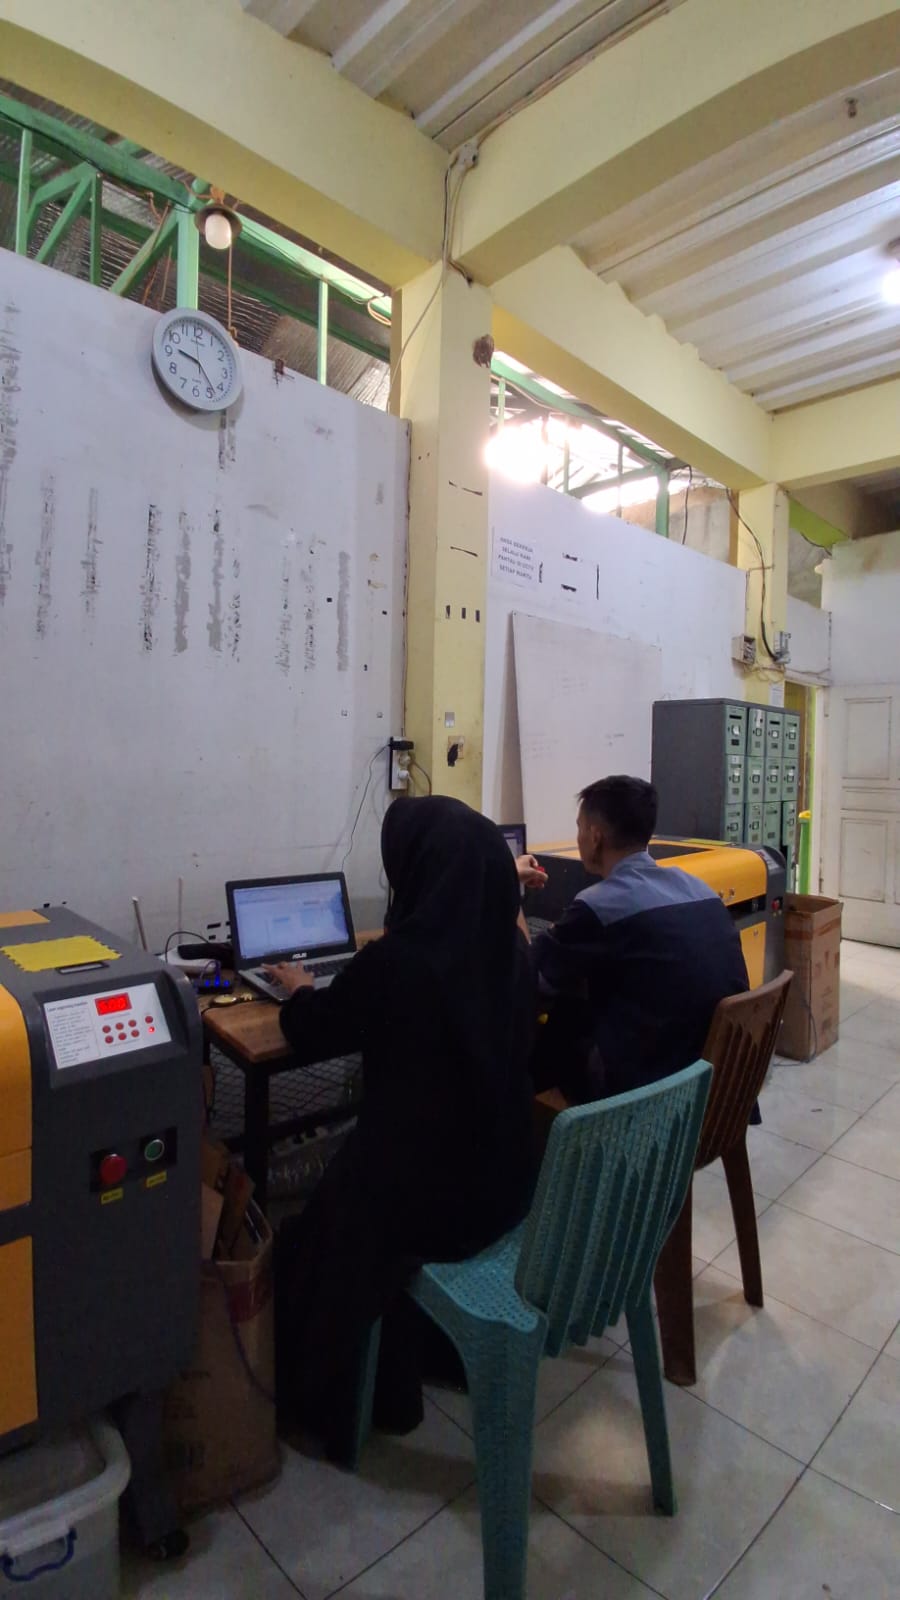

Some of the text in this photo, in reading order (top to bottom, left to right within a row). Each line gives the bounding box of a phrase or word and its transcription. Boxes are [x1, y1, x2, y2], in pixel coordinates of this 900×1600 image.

[181, 324, 189, 336] 11
[193, 325, 203, 340] 12
[169, 330, 181, 344] 10
[164, 345, 173, 357] 9
[217, 350, 225, 362] 2
[169, 362, 177, 375] 8
[221, 367, 228, 379] 3
[179, 377, 188, 389] 7
[216, 382, 224, 392] 4
[192, 385, 200, 397] 6
[205, 387, 213, 399] 5
[502, 546, 519, 557] SELALU
[498, 554, 516, 565] PANTAU
[499, 564, 516, 574] SETIAP
